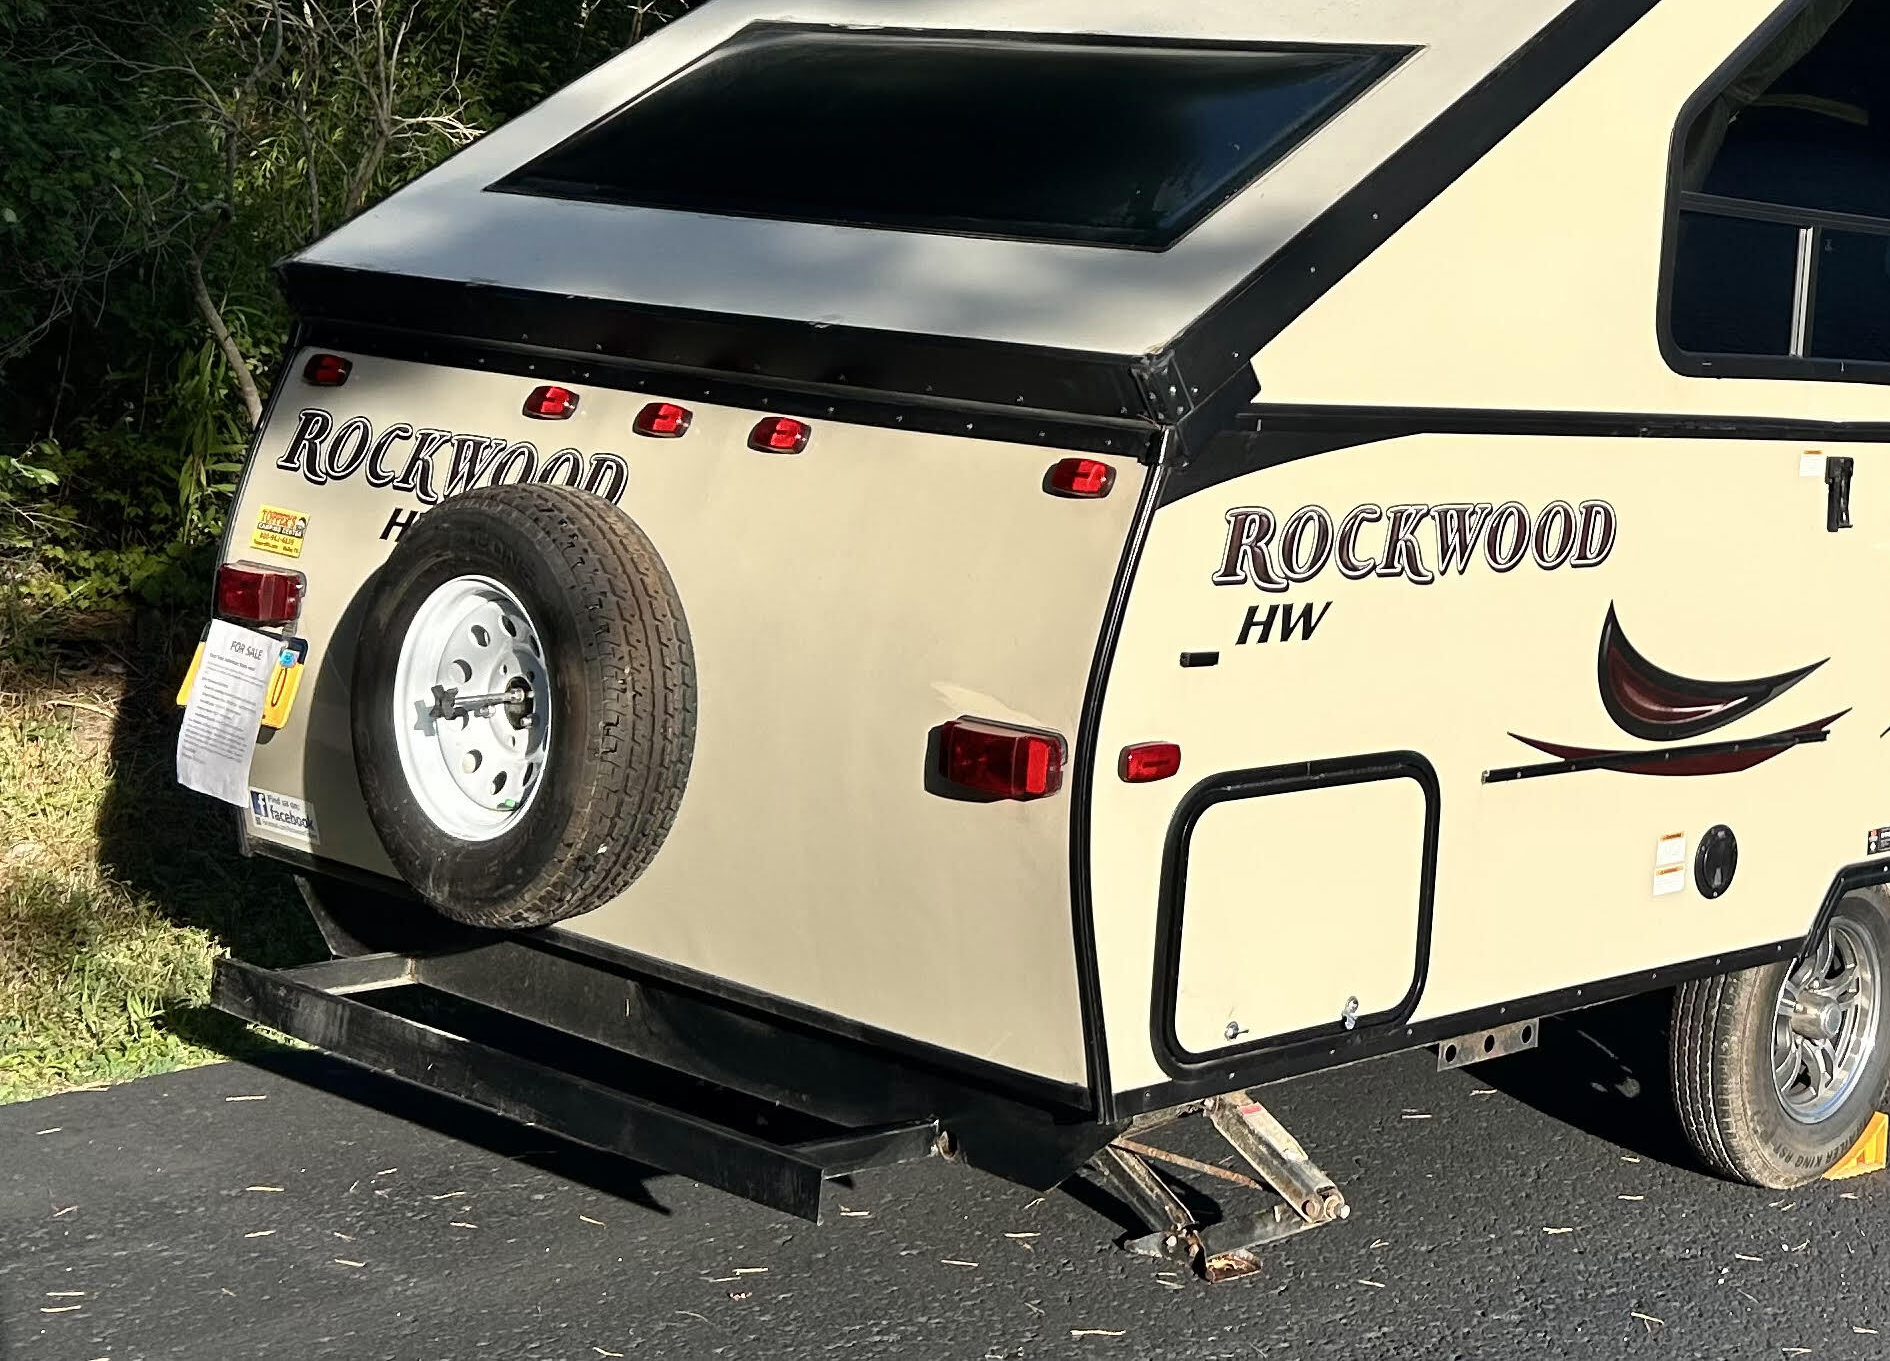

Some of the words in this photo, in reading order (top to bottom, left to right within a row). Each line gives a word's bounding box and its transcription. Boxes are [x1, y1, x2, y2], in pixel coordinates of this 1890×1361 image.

[277, 408, 629, 507] ROCKWOOD
[379, 507, 426, 543] H
[1212, 499, 1618, 593] ROCKWOOD
[1235, 600, 1333, 646] HW
[230, 640, 246, 656] FOR
[245, 644, 264, 661] SALE
[267, 794, 281, 805] Find
[270, 805, 315, 830] facebook
[1795, 1155, 1823, 1169] KING
